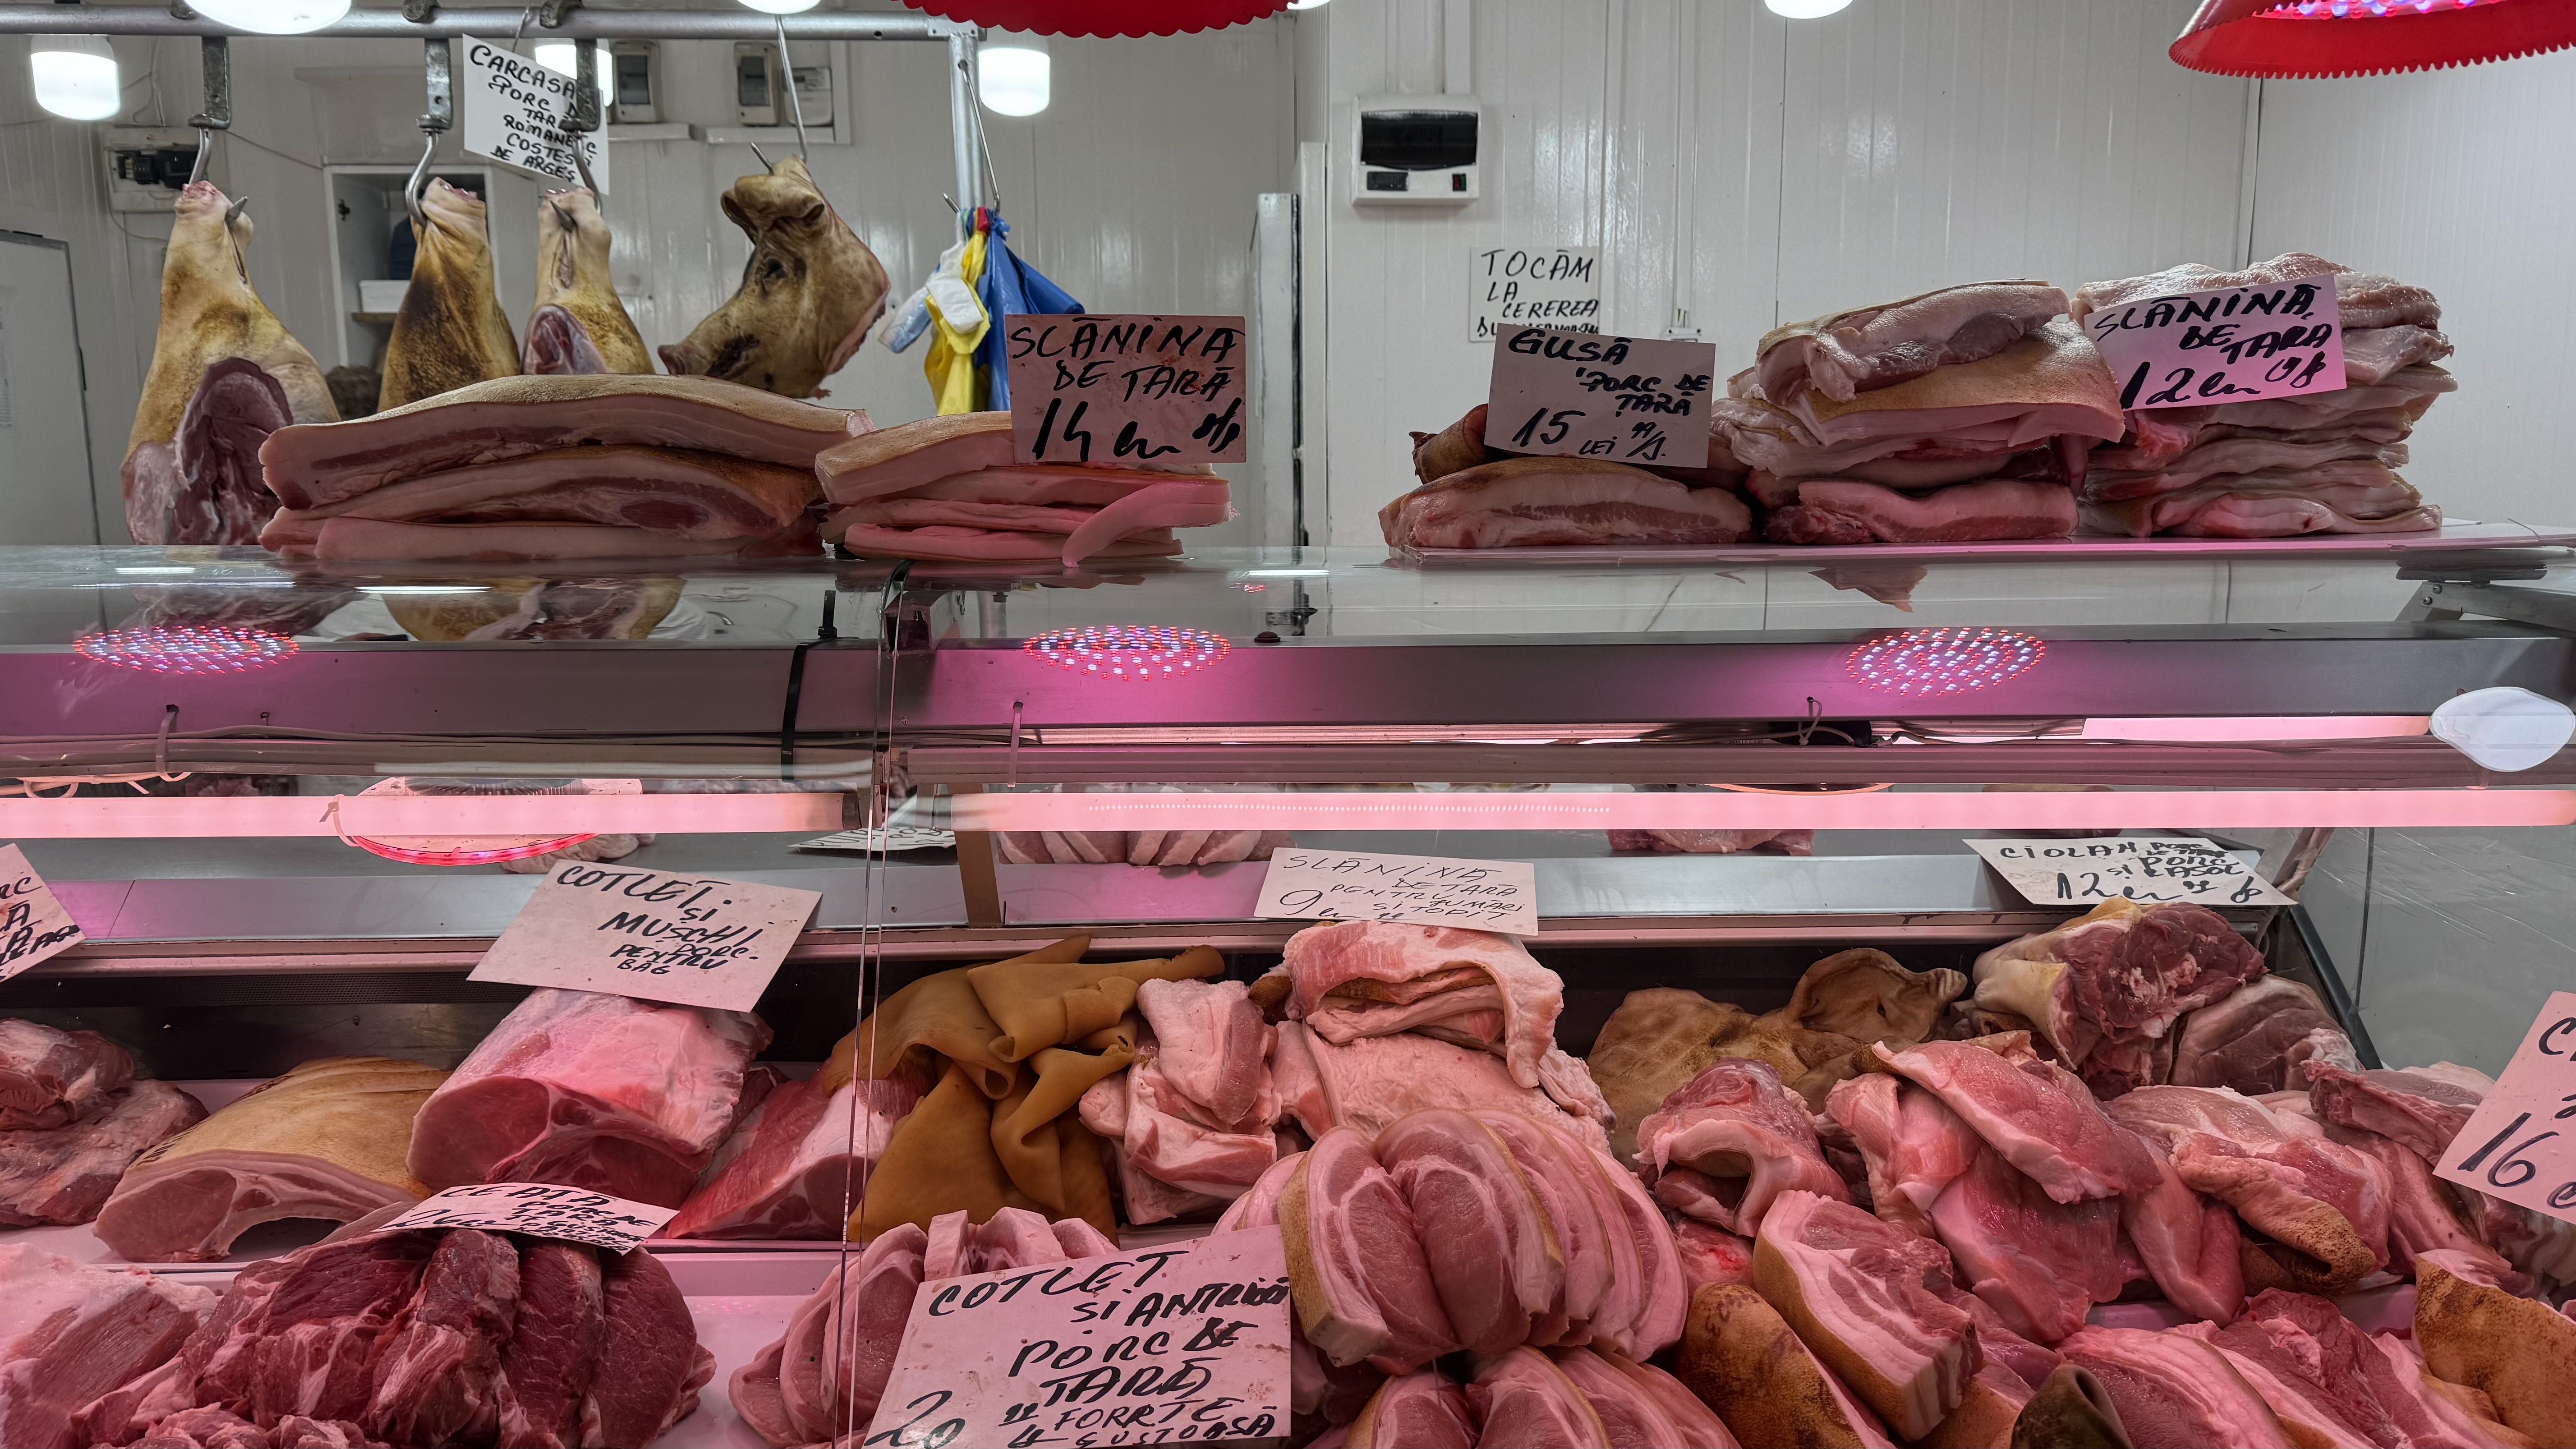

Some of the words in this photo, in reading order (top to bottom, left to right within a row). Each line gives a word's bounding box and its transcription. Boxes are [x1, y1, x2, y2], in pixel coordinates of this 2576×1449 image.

[488, 74, 551, 112] PORC
[490, 145, 514, 161] DE
[1487, 281, 1518, 303] LA
[1502, 299, 1599, 318] CEREREA
[2179, 324, 2241, 350] DE
[1053, 359, 1115, 391] DE
[1674, 373, 1711, 391] DE
[2120, 361, 2195, 409] 12
[1032, 397, 1091, 462] 14
[1512, 407, 1586, 447] 15
[557, 866, 731, 909] COTLET
[1330, 884, 1455, 901] PENTRU
[1392, 878, 1435, 889] DE
[2457, 1112, 2560, 1187] 16
[929, 1250, 1189, 1317] COTLET
[1008, 1331, 1169, 1377] PORC
[1182, 1317, 1259, 1351] DE
[863, 1390, 966, 1449] 20
